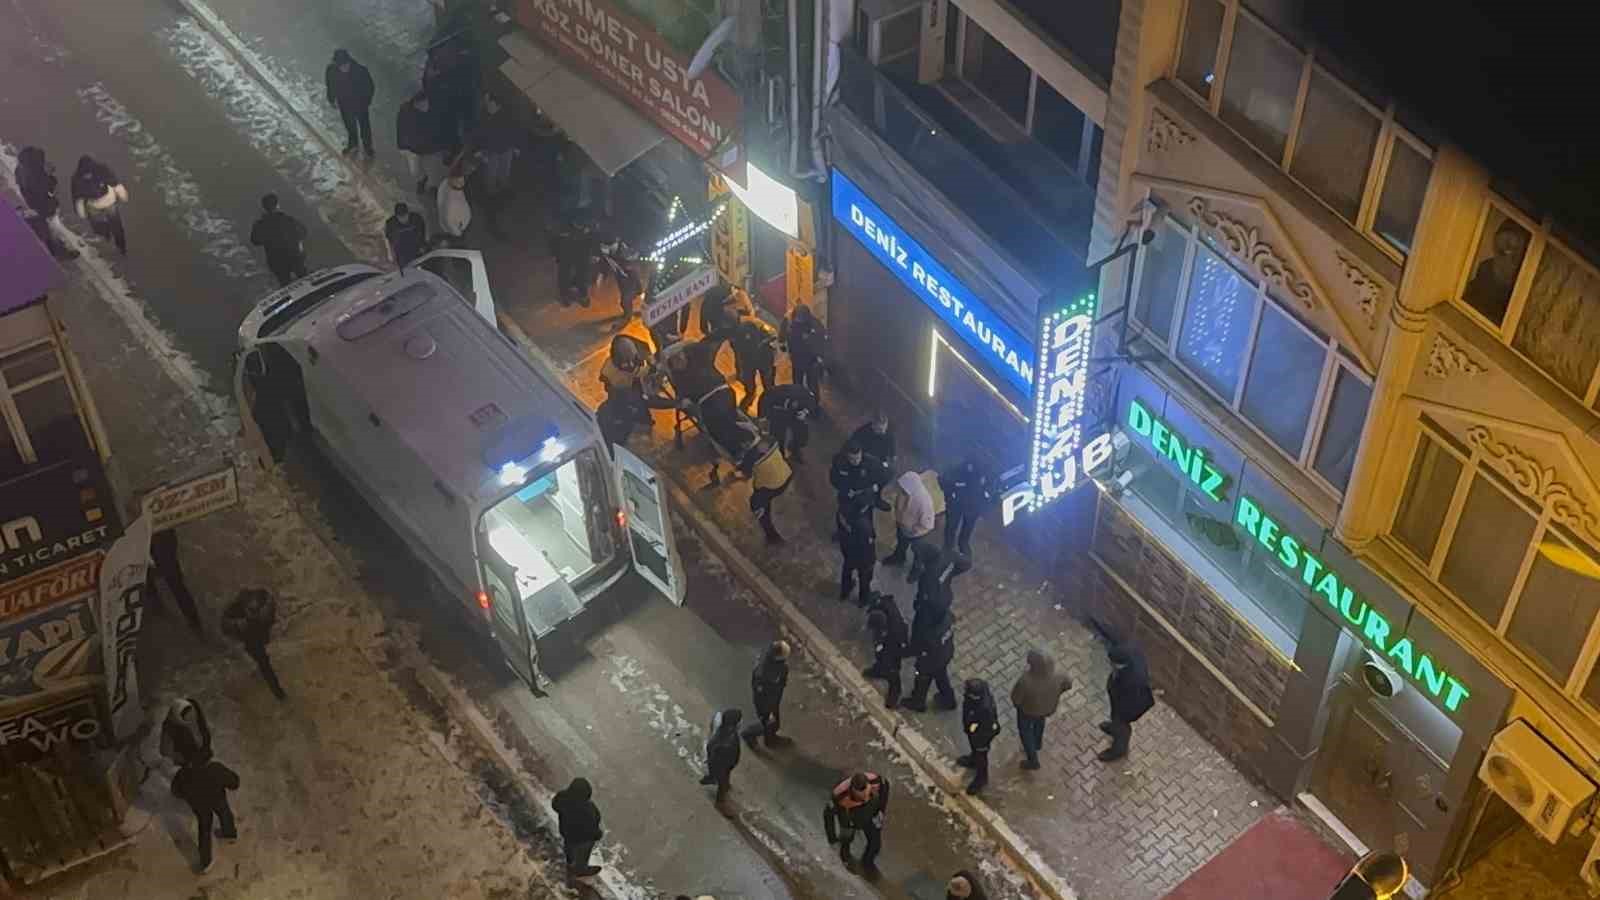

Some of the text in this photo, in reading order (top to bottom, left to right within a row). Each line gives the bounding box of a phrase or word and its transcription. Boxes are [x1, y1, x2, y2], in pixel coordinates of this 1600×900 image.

[576, 23, 643, 85] DÖNER
[644, 41, 711, 109] USTA
[850, 203, 909, 268] DENİZ
[912, 260, 1034, 385] RESTAURAN
[1003, 432, 1113, 527] PUB
[0, 515, 42, 555] n
[1127, 399, 1470, 712] DENİZ RESTAURANT
